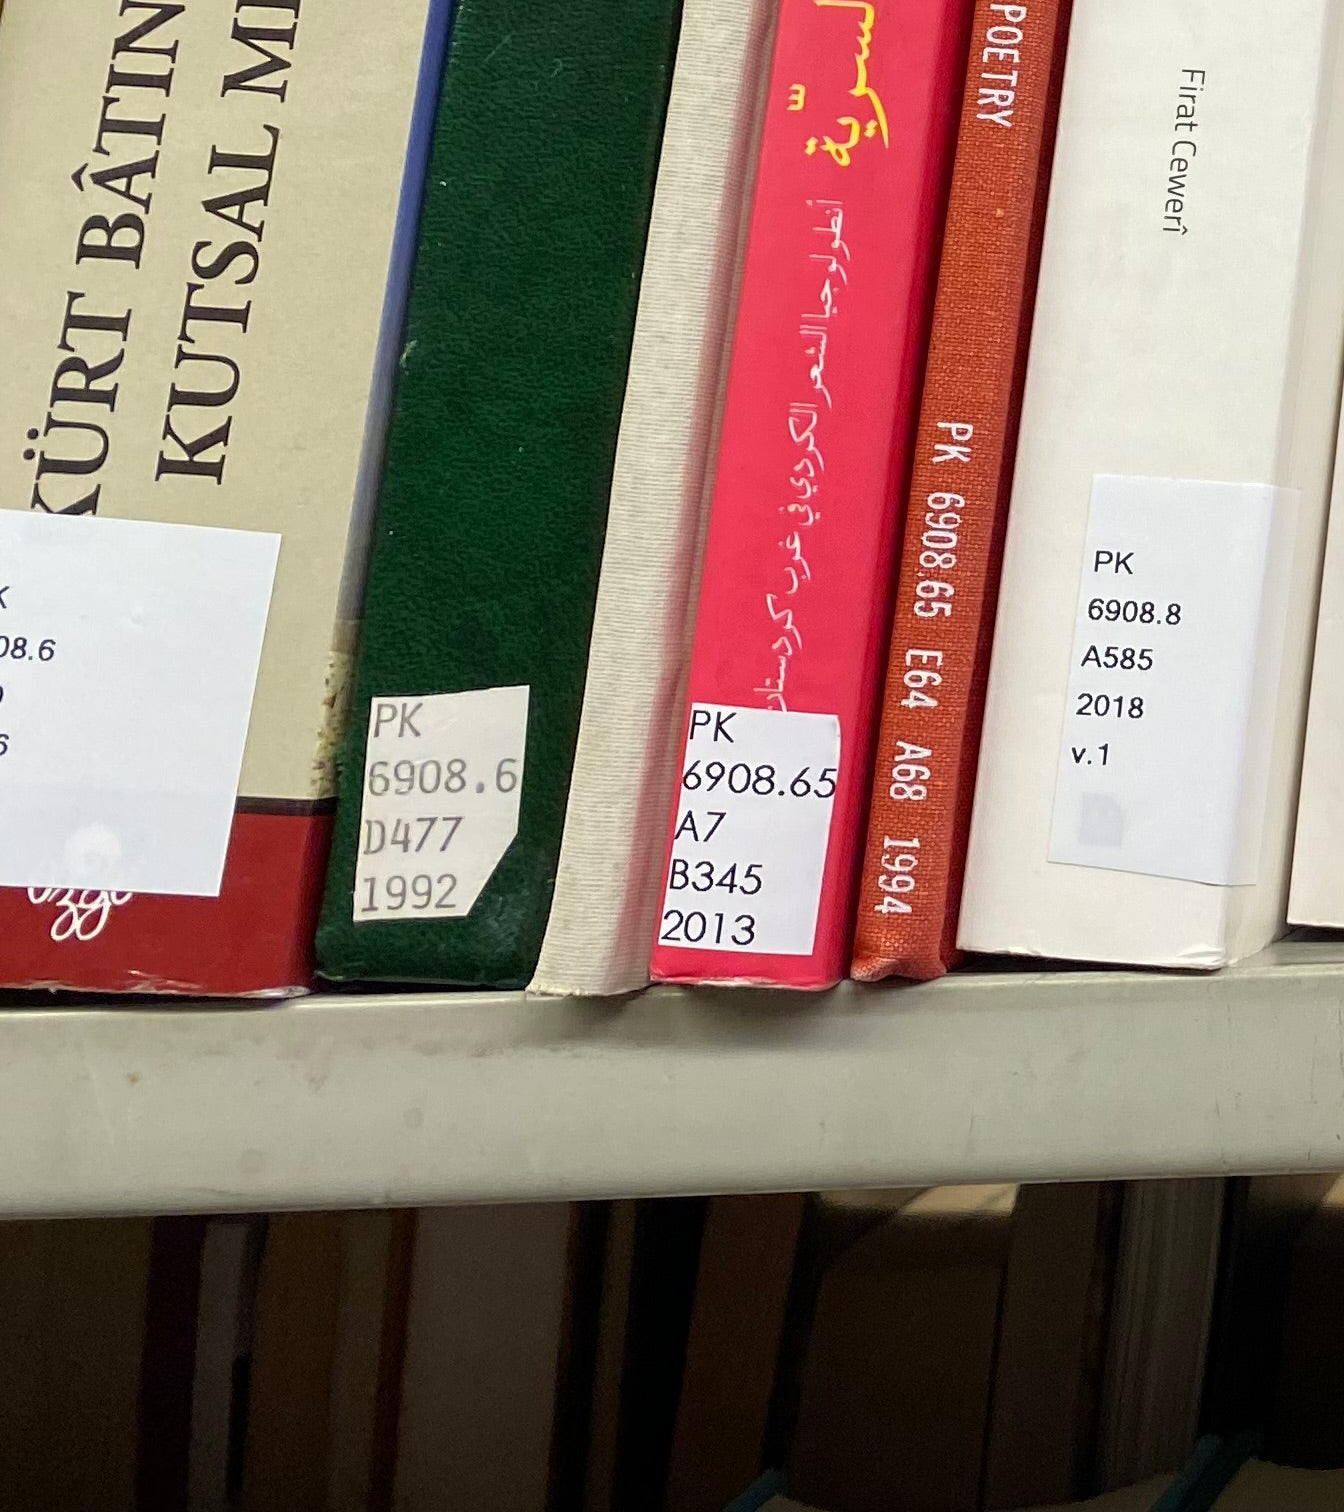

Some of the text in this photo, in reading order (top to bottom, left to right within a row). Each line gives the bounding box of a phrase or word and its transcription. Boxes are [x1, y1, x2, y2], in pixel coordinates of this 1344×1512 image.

[976, 2, 1023, 129] POETRY
[1162, 68, 1206, 236] Firat Cewerî
[156, 124, 279, 486] KUTSAL
[1094, 550, 1134, 575] PK
[1087, 599, 1182, 626] 6908.8
[873, 420, 974, 916] PK 6908.65 E64 A68 1994
[1081, 645, 1154, 671] A585
[372, 703, 422, 738] PK
[1075, 694, 1144, 720] 2018
[689, 710, 735, 742] PK
[1071, 744, 1110, 767] v.1
[368, 759, 519, 796] 6908.6
[682, 763, 837, 797] 6908.65
[363, 816, 463, 856] D477
[675, 811, 723, 844] A7
[360, 873, 457, 914] 1992
[669, 861, 762, 895] B345
[659, 910, 755, 945] 2013
